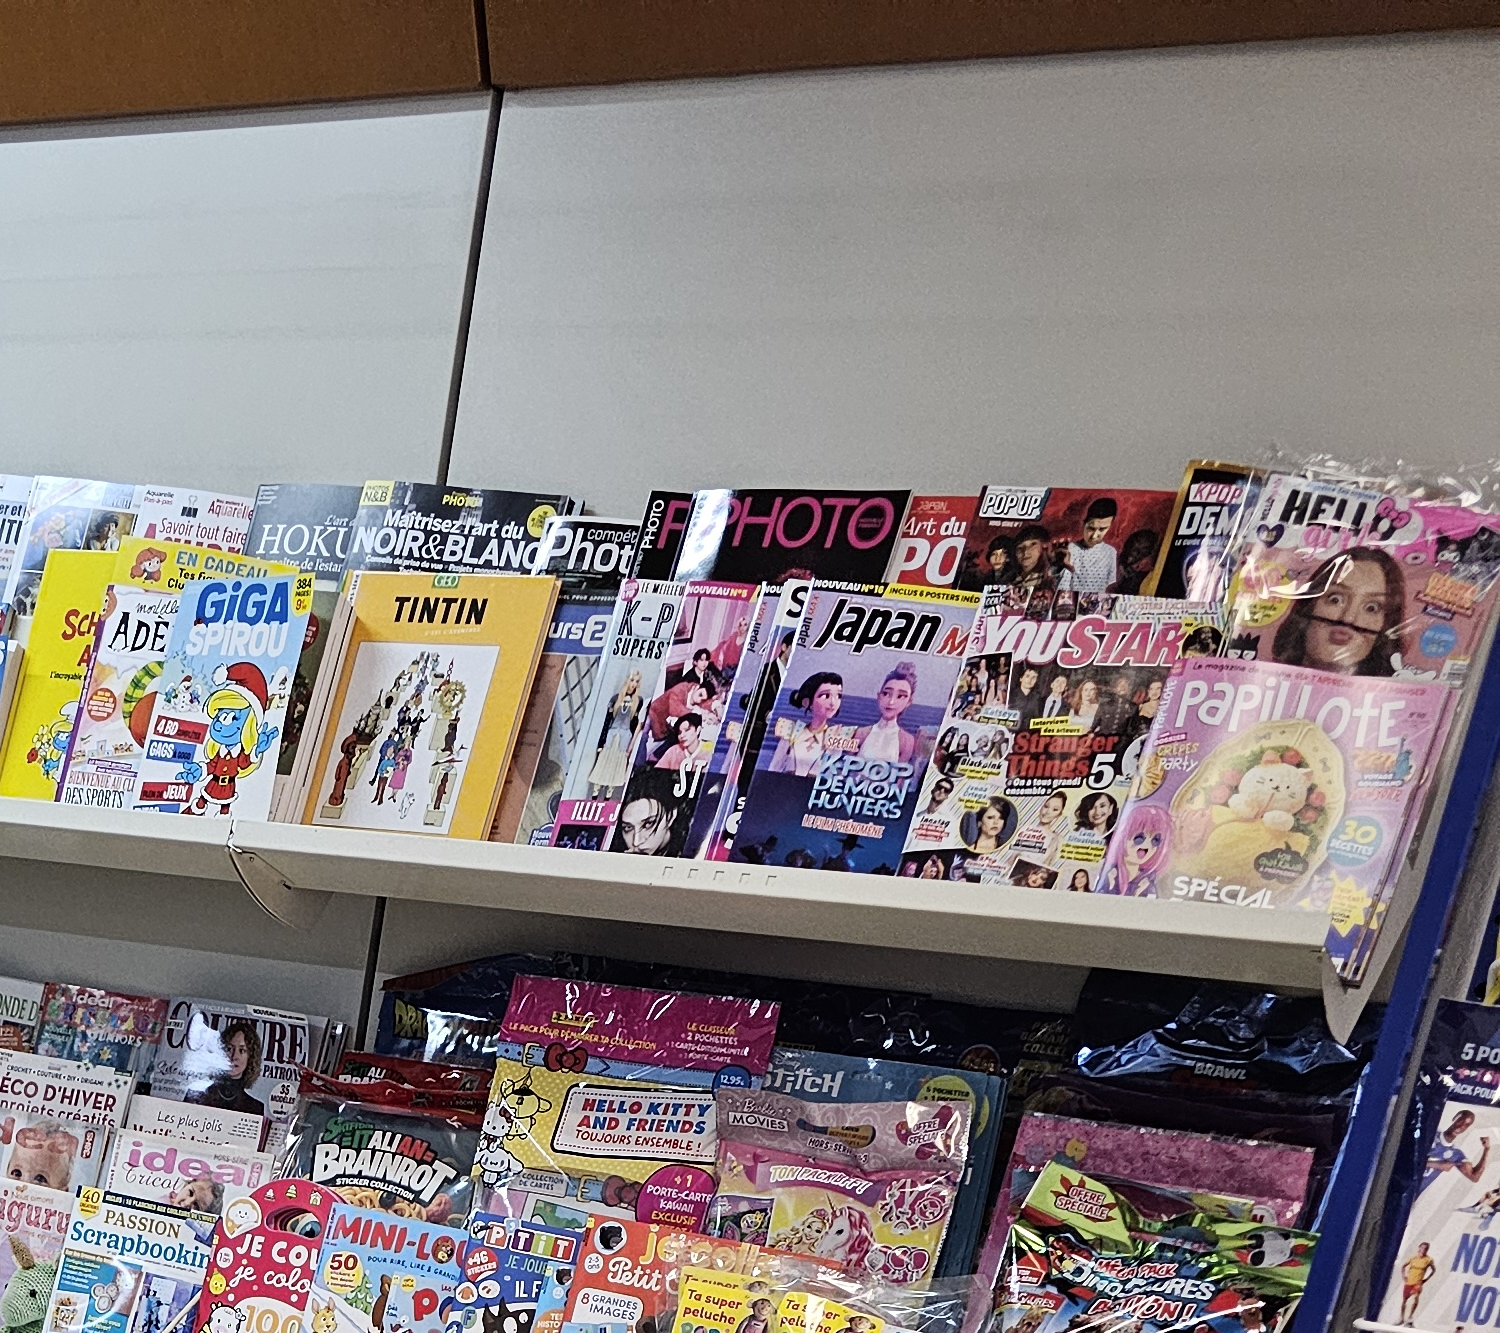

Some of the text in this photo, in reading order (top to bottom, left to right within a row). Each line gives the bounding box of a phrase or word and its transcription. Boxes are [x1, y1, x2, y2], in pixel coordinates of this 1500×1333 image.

[364, 490, 388, 503] N&B
[983, 492, 1041, 516] POP UP
[160, 517, 248, 545] Savoir tout faire
[384, 509, 524, 539] Maîtrisez du
[729, 496, 895, 550] PHOTO
[814, 580, 861, 592] NOUVEAU
[889, 587, 958, 602] INCLUS POSTERS
[394, 596, 488, 625] TINTIN
[814, 597, 942, 657] Japan
[1014, 731, 1118, 757] Stranger
[68, 772, 110, 791] BIENVENUE
[1008, 754, 1116, 789] Things 5
[65, 787, 124, 808] DES SPORTS
[816, 774, 909, 804] DEMON
[809, 789, 901, 820] HUNTERS
[802, 814, 834, 830] LE FILM
[1343, 820, 1377, 845] 30
[1329, 837, 1374, 859] RECETTES
[1173, 875, 1276, 910] SPÉCIAL
[42, 1082, 118, 1113] D'HIVER
[581, 1098, 713, 1119] HELLO KITTY
[578, 1114, 706, 1135] AND FRIENDS
[575, 1129, 696, 1152] TOUJOURS ENSEMBLE
[312, 1142, 460, 1203] BRAINROT
[336, 1175, 415, 1201] STICKER COLLECTION
[1067, 1184, 1106, 1207] OFFRE
[1056, 1195, 1114, 1220] SPÉCIALE
[103, 1209, 182, 1240] PASSION
[329, 1254, 359, 1271] 50
[588, 1304, 636, 1322] IMAGES
[593, 1294, 639, 1312] GRANDES
[682, 1305, 736, 1326] peluche
